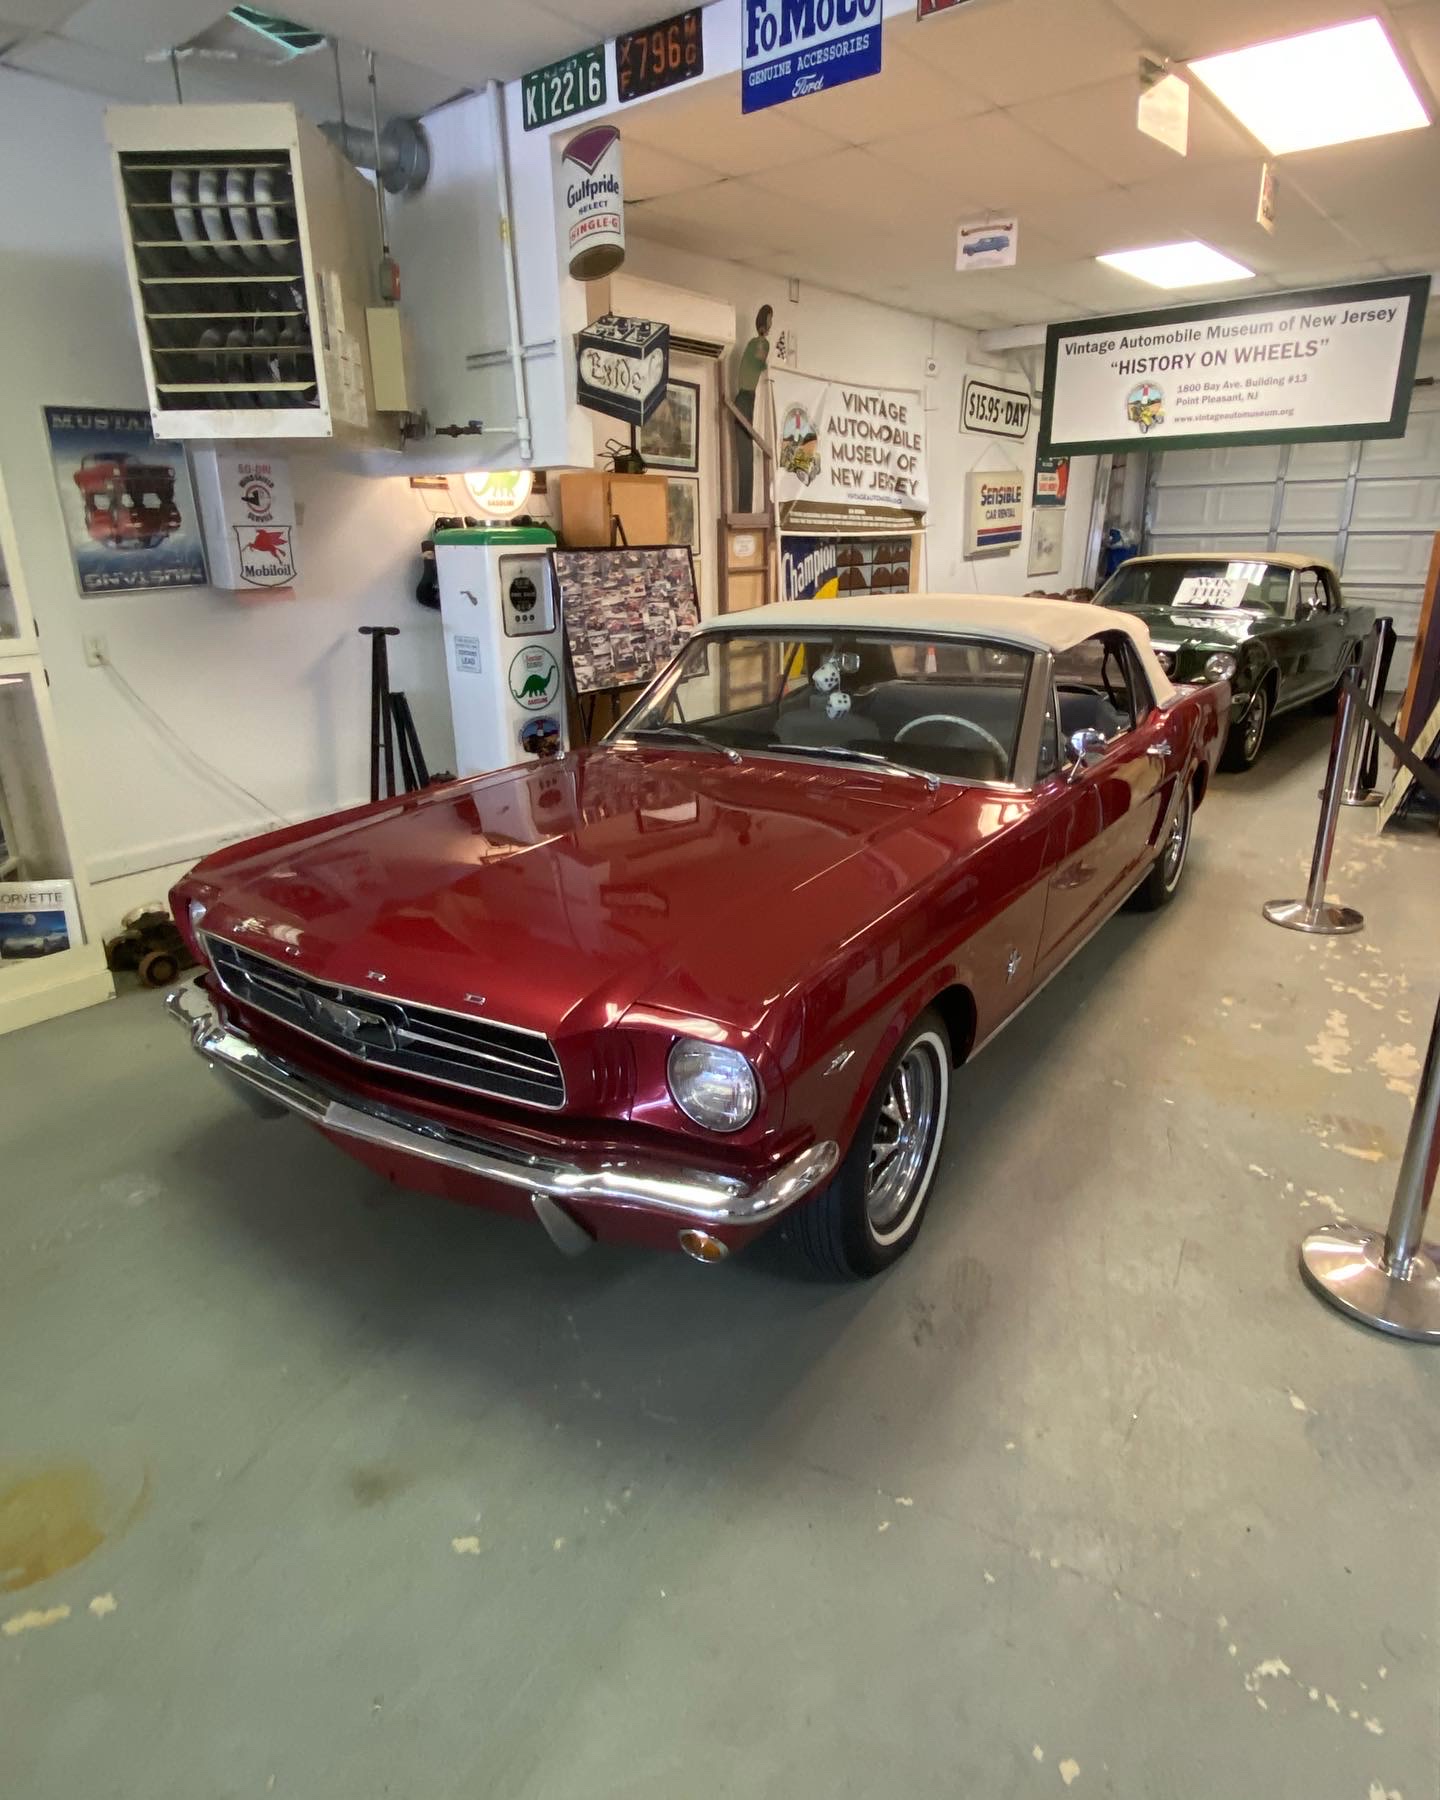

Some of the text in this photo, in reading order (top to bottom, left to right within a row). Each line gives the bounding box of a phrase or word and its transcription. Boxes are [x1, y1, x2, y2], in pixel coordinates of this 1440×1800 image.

[749, 34, 870, 86] GENUINE ACCESSORIES
[526, 61, 601, 125] K12216
[791, 73, 825, 98] Ford
[567, 174, 619, 208] Gulfpride
[579, 200, 607, 215] SELECT
[571, 217, 618, 240] SINGLE-G
[1065, 306, 1398, 356] Vintage Automobile Museum of New Jersey
[1110, 338, 1330, 376] “HISTORY ON WHEELS”
[1177, 374, 1308, 393] 1800 Bay Ave. Building #13
[842, 391, 907, 424] VINTAGE
[1176, 391, 1259, 406] Point Pleasant, NJ
[51, 413, 151, 431] MUSTA
[1174, 408, 1295, 423] www.vintageautomuseum.org
[827, 415, 921, 451] AUTOMOBILE
[897, 453, 917, 473] OF
[831, 468, 919, 496] NEW JERSEY
[245, 565, 291, 577] Mobiloil
[782, 542, 837, 601] Champion
[0, 892, 64, 905] ORVETTE
